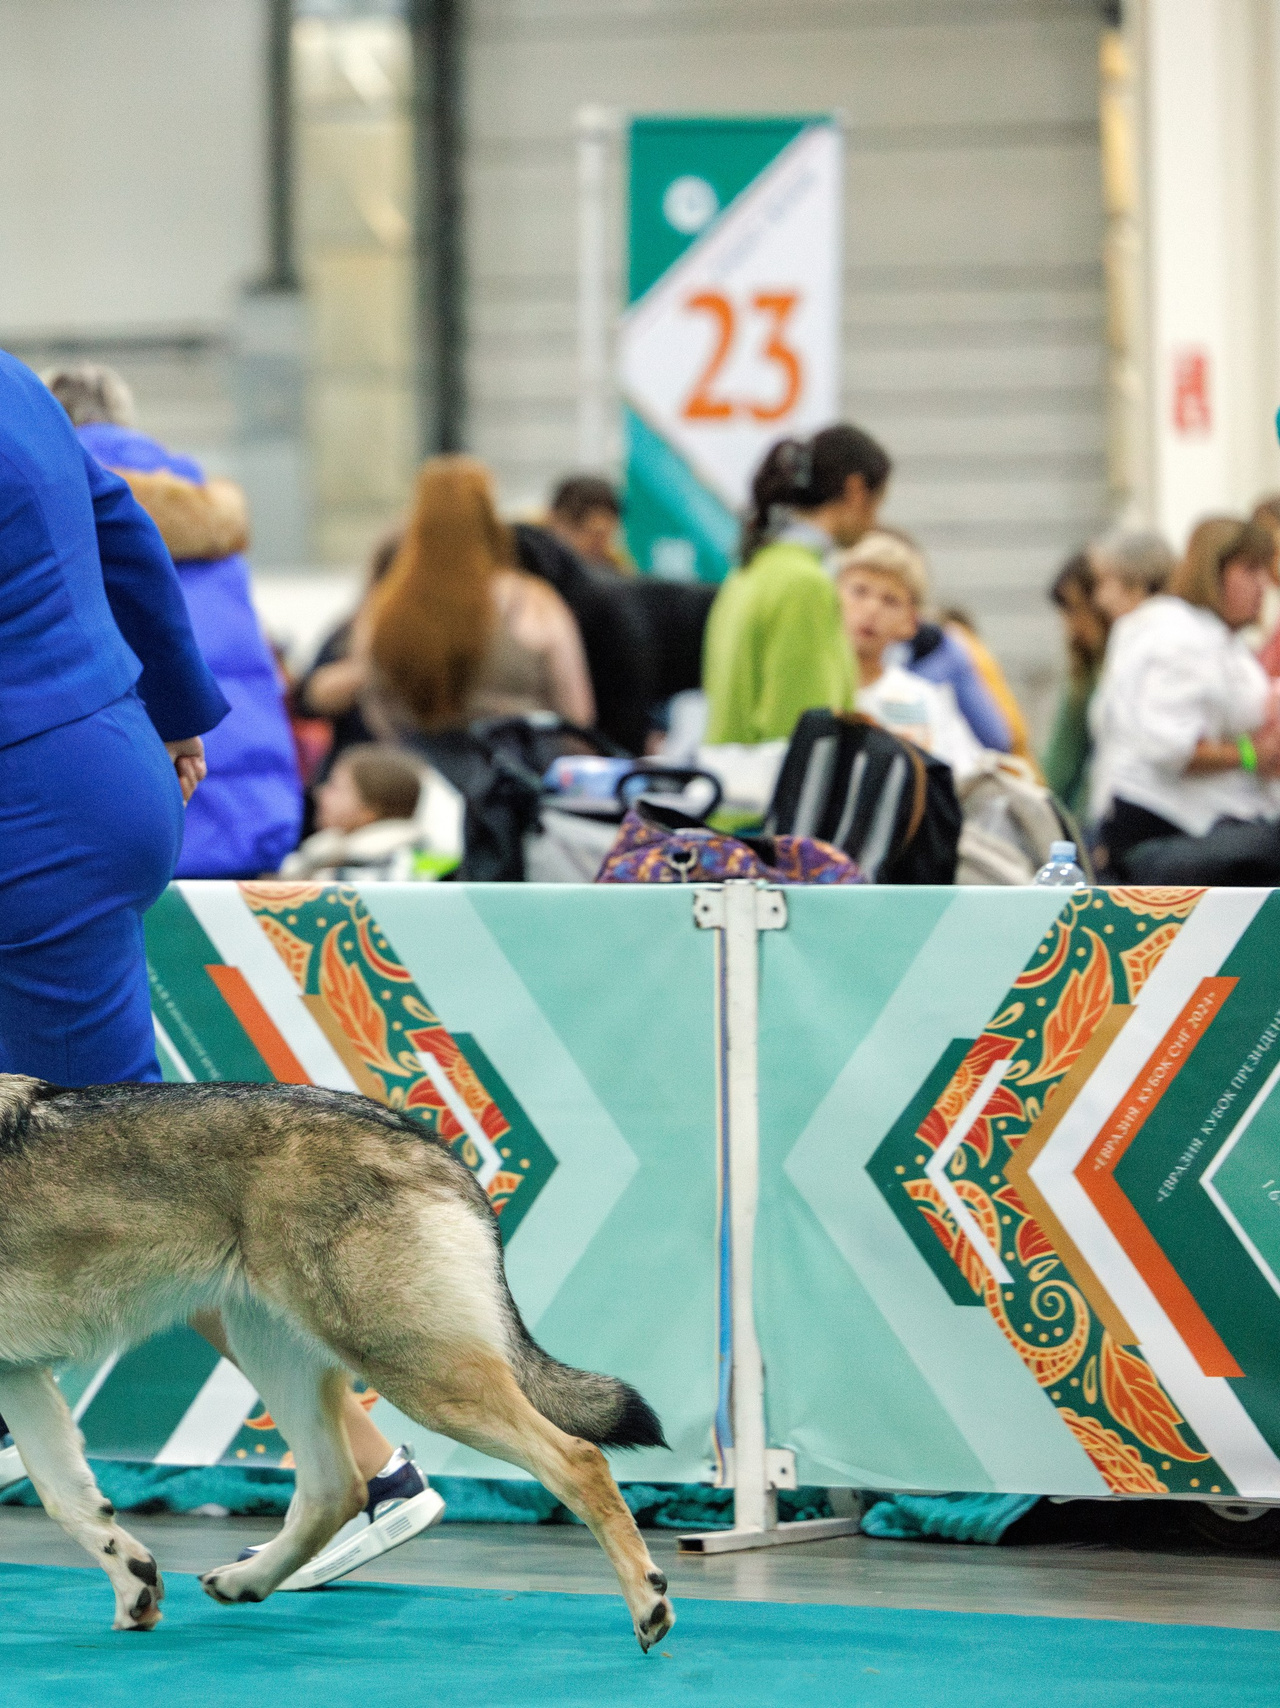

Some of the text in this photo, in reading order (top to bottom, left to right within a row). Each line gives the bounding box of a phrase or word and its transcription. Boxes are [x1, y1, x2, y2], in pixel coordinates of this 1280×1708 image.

[681, 292, 804, 421] 23
[1137, 1057, 1174, 1103] КУБОК
[1167, 1027, 1191, 1058] СНГ
[1200, 1087, 1238, 1136] КУБОК
[1230, 1008, 1280, 1091] ПРЕЗИДЕН
